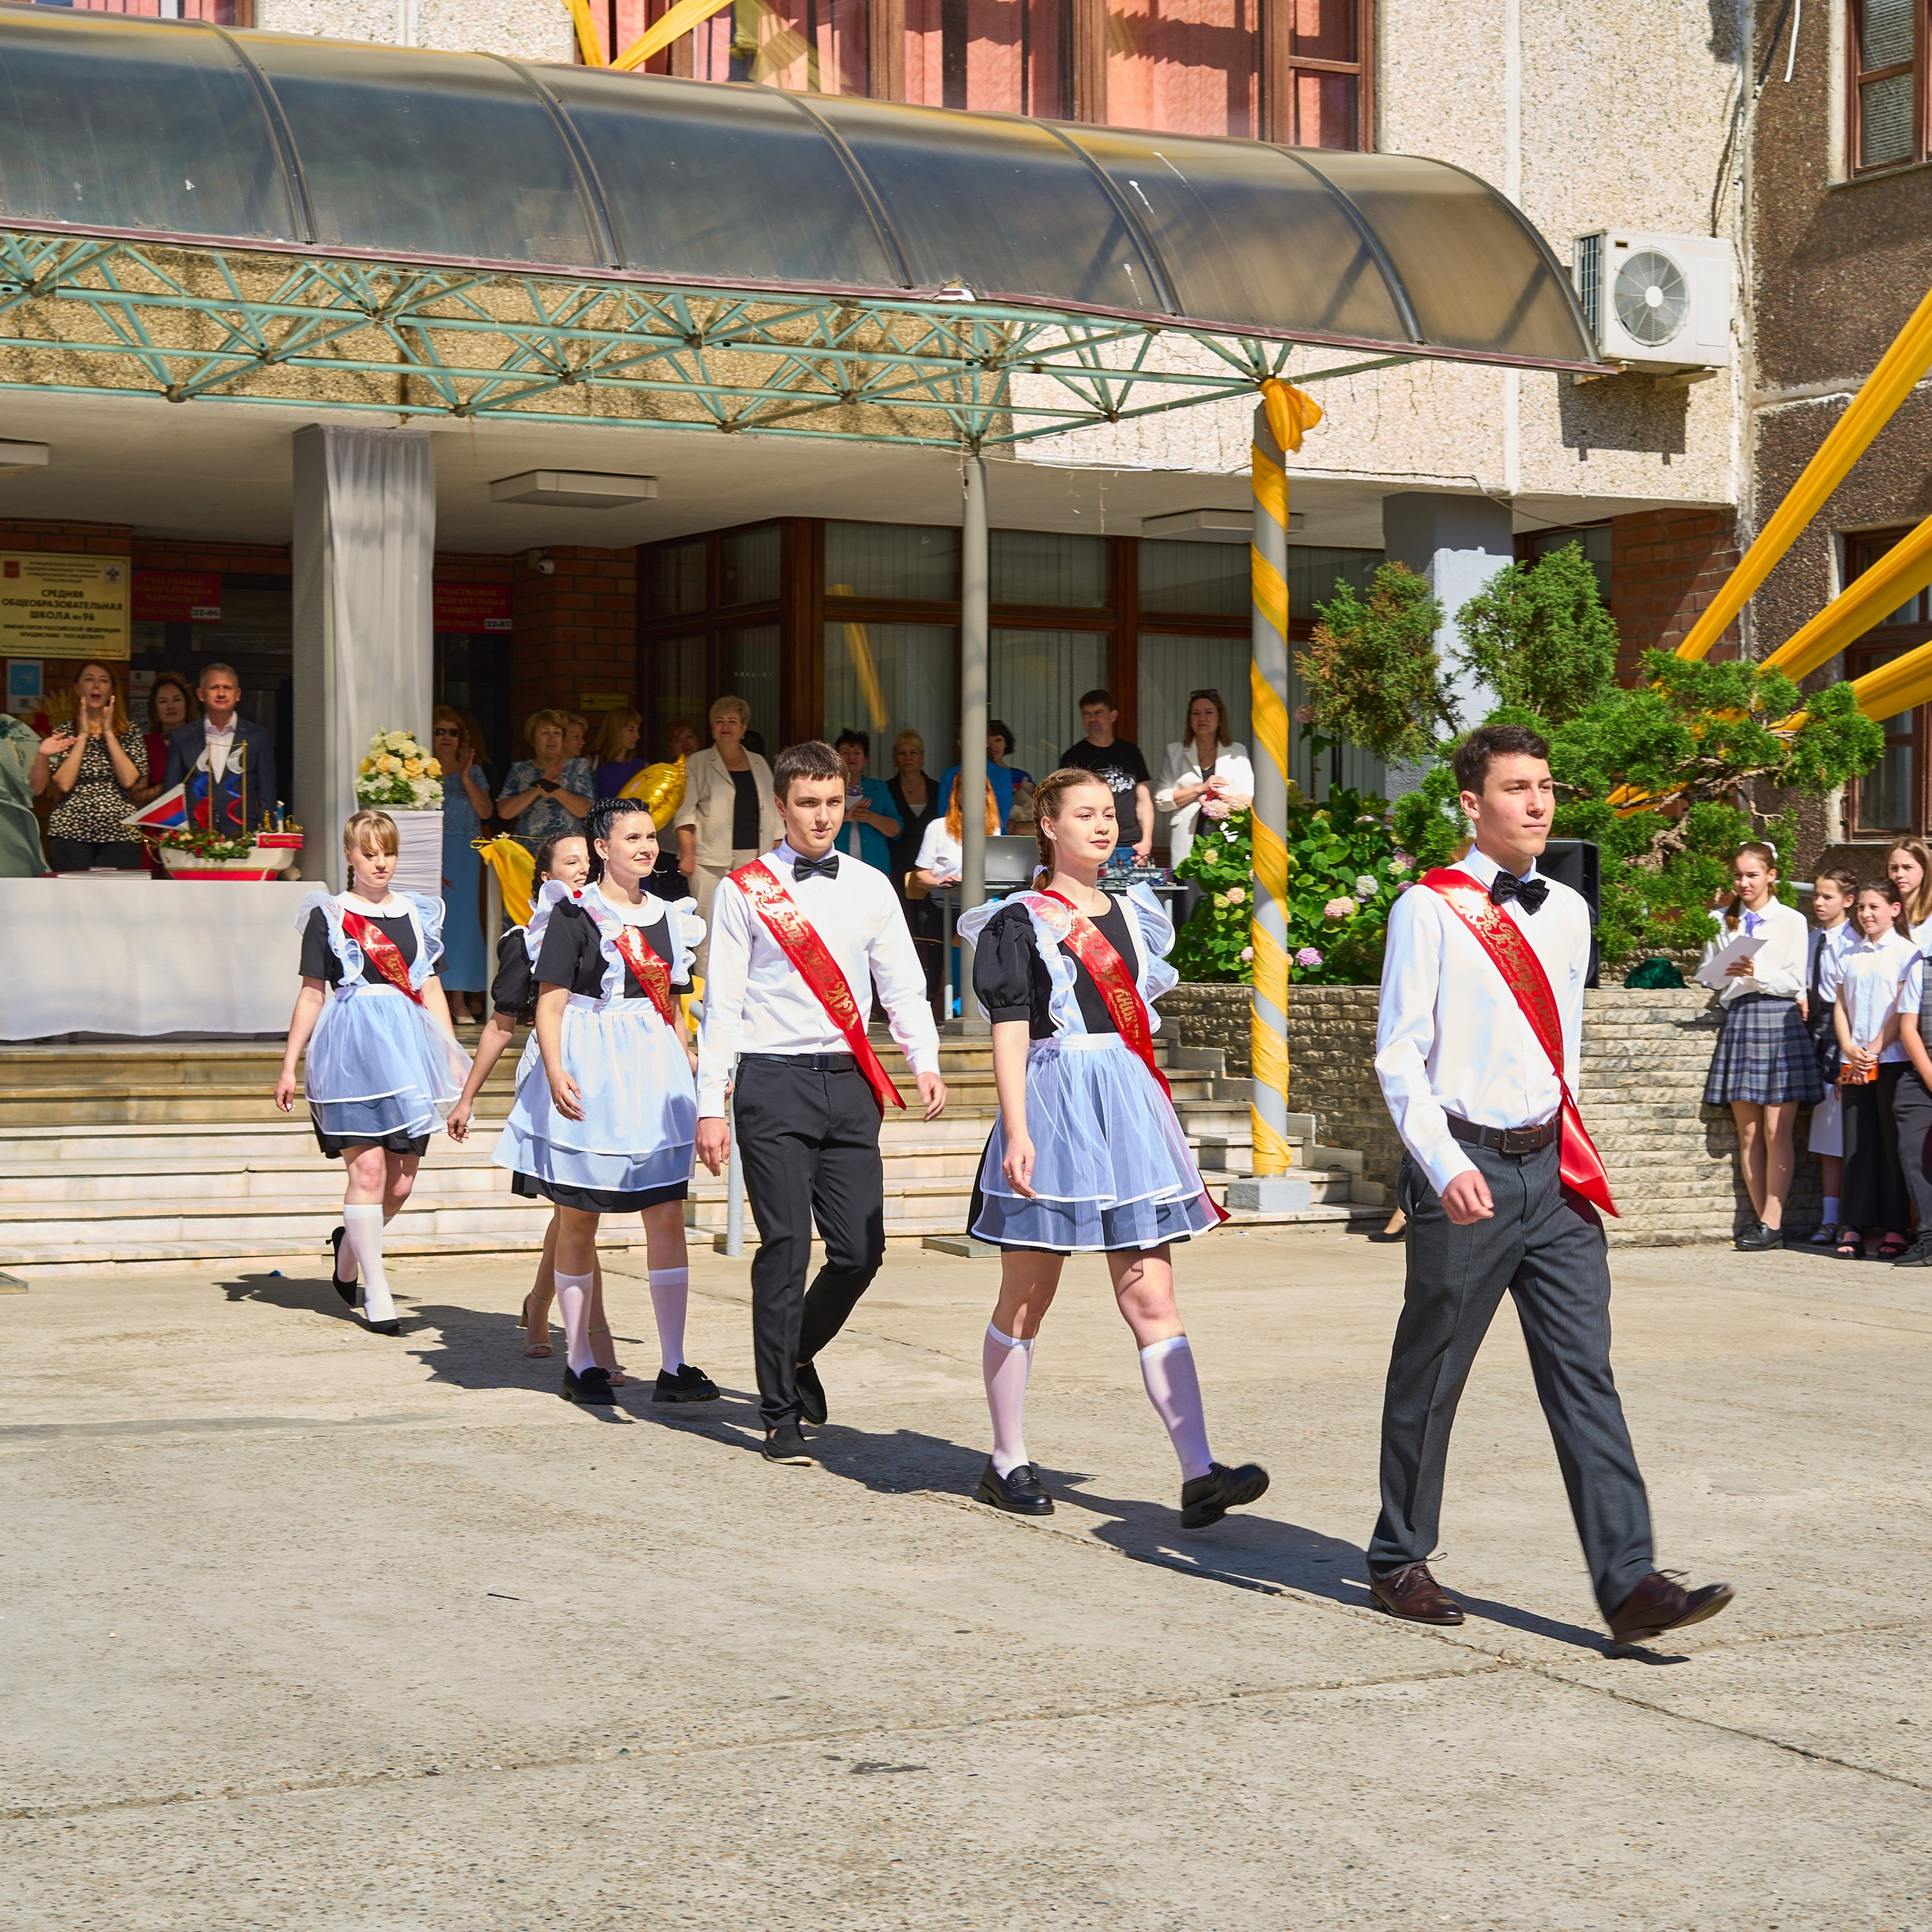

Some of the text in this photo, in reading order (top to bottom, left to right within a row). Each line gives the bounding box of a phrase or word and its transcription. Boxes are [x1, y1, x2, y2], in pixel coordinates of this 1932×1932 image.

[41, 589, 84, 598] СРЕДНЯЯ
[2, 598, 123, 610] ОБЩЕОБРАЗОВАТЕЛЬНАЯ
[29, 611, 70, 620] ШКОЛА
[1483, 921, 1561, 1044] Выпускник
[821, 979, 860, 1030] 2024
